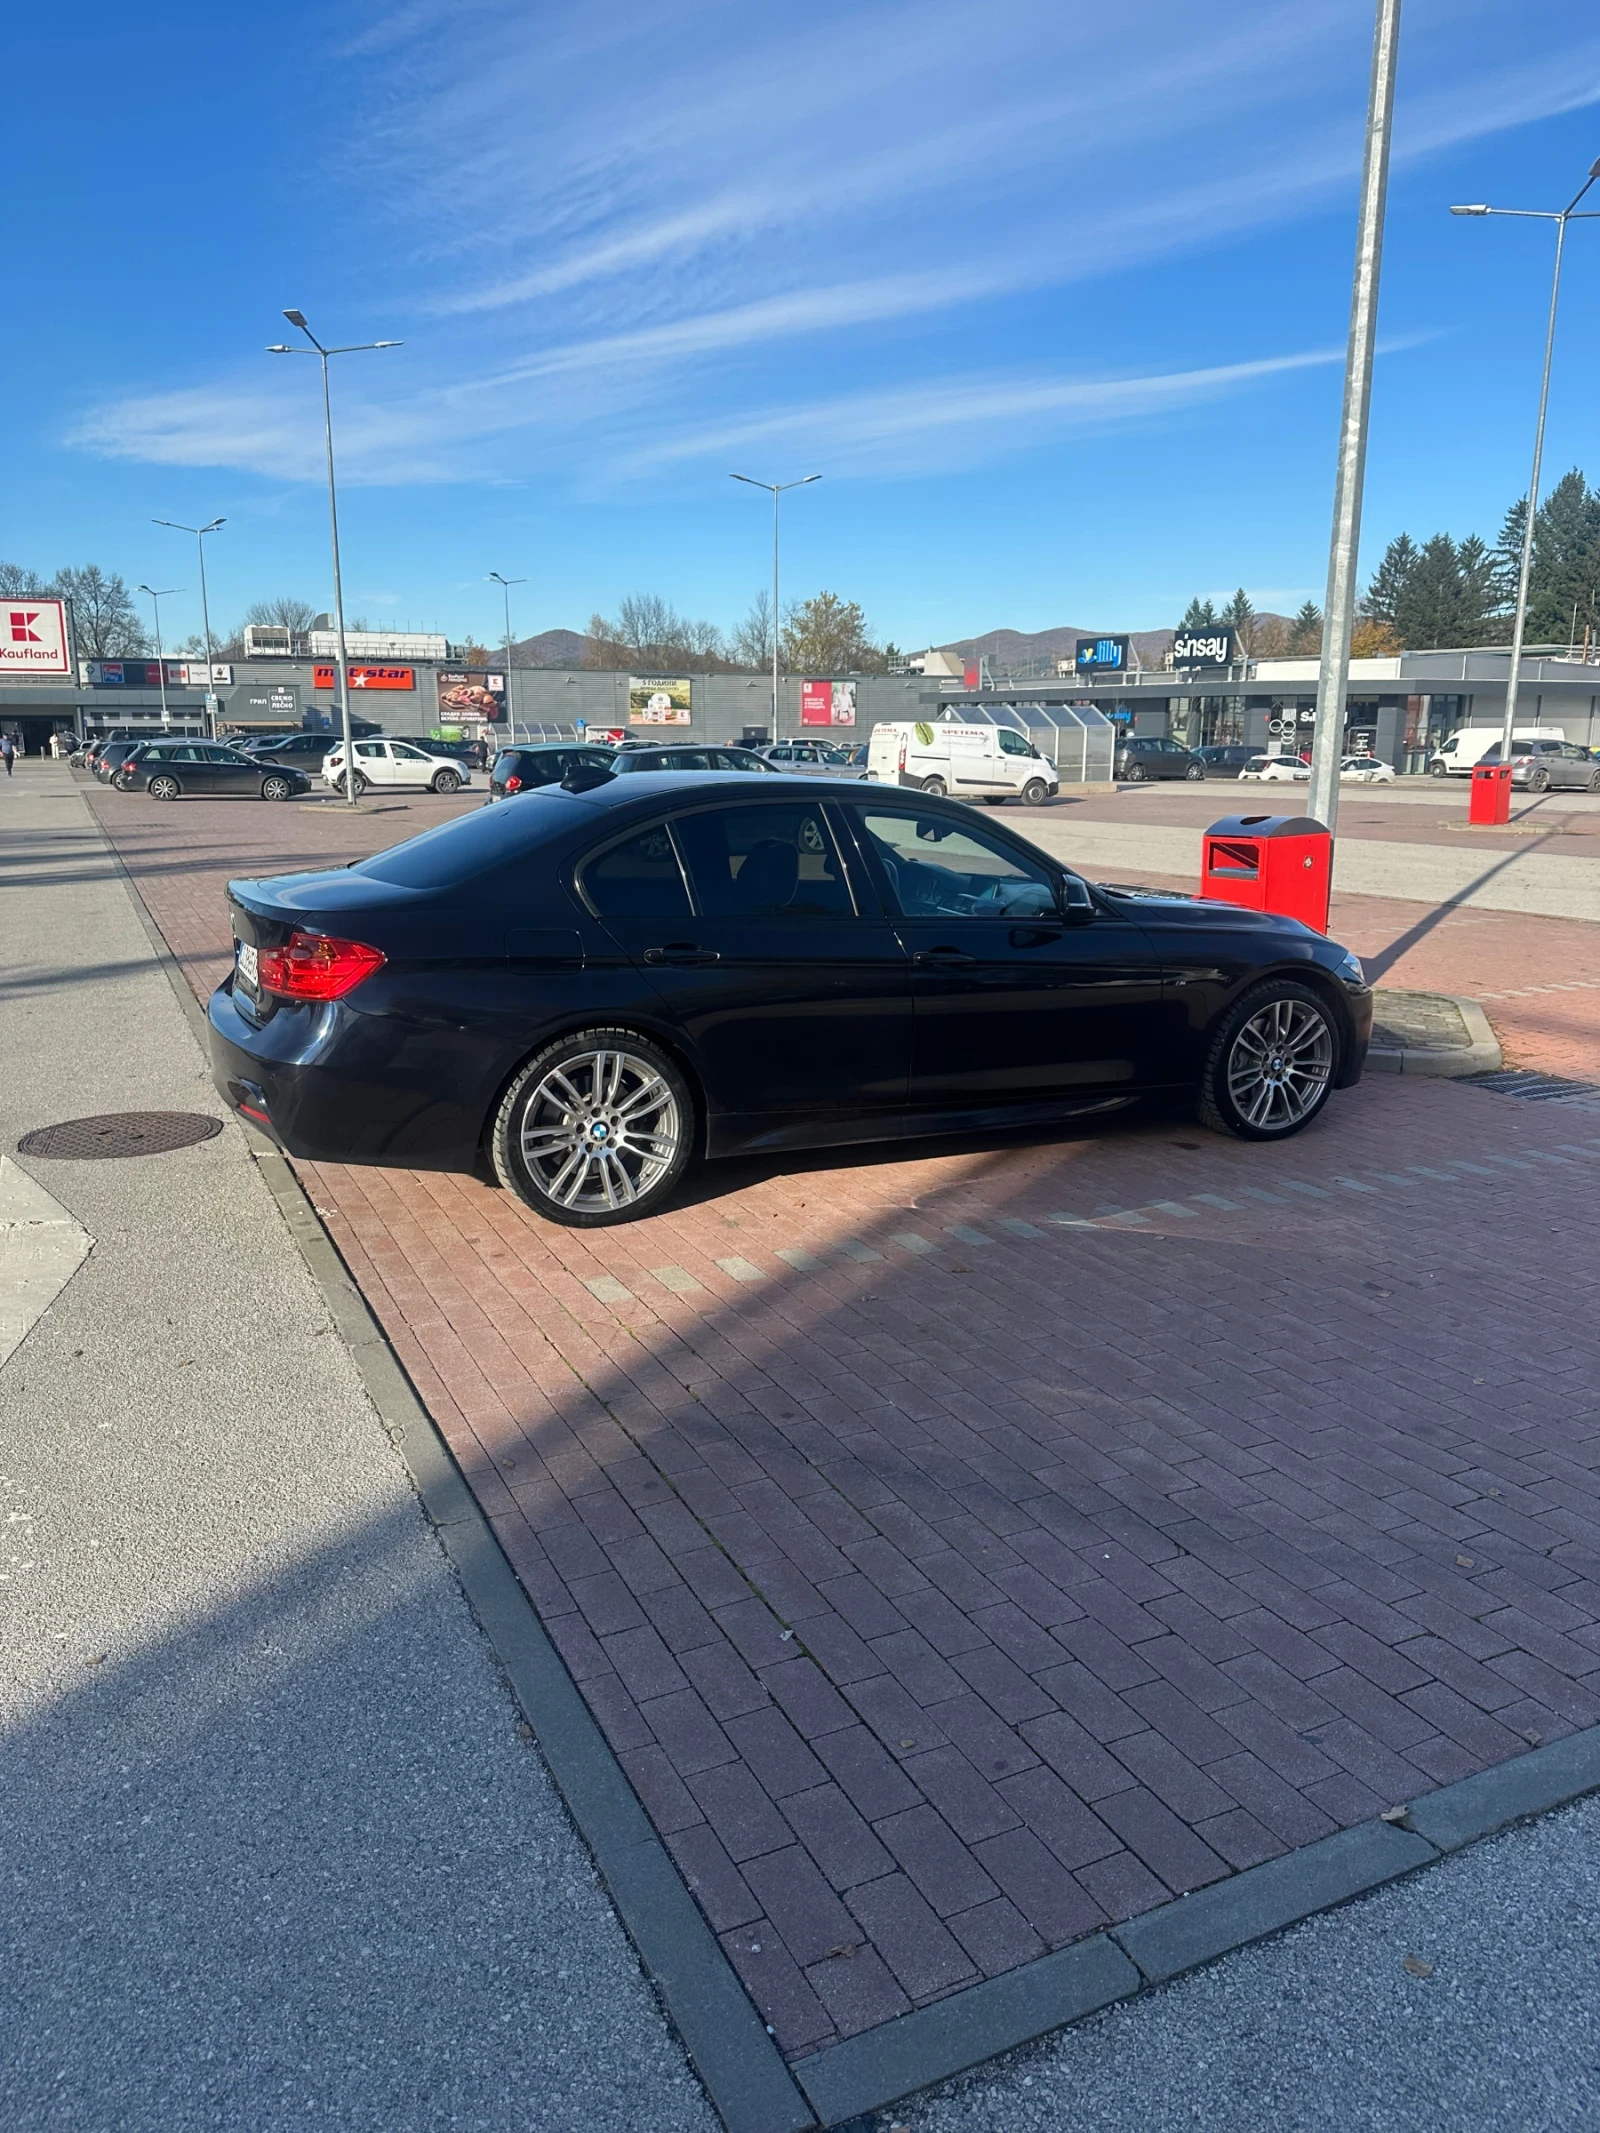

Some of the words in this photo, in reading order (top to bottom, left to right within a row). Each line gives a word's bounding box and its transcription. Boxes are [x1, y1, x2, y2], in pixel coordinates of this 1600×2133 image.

[0, 648, 59, 660] Kaufland
[1174, 633, 1228, 663] sinsay
[1096, 640, 1122, 669] lilly
[103, 666, 122, 674] Easy
[317, 667, 358, 678] mt
[366, 668, 409, 679] star
[104, 673, 119, 681] Pay
